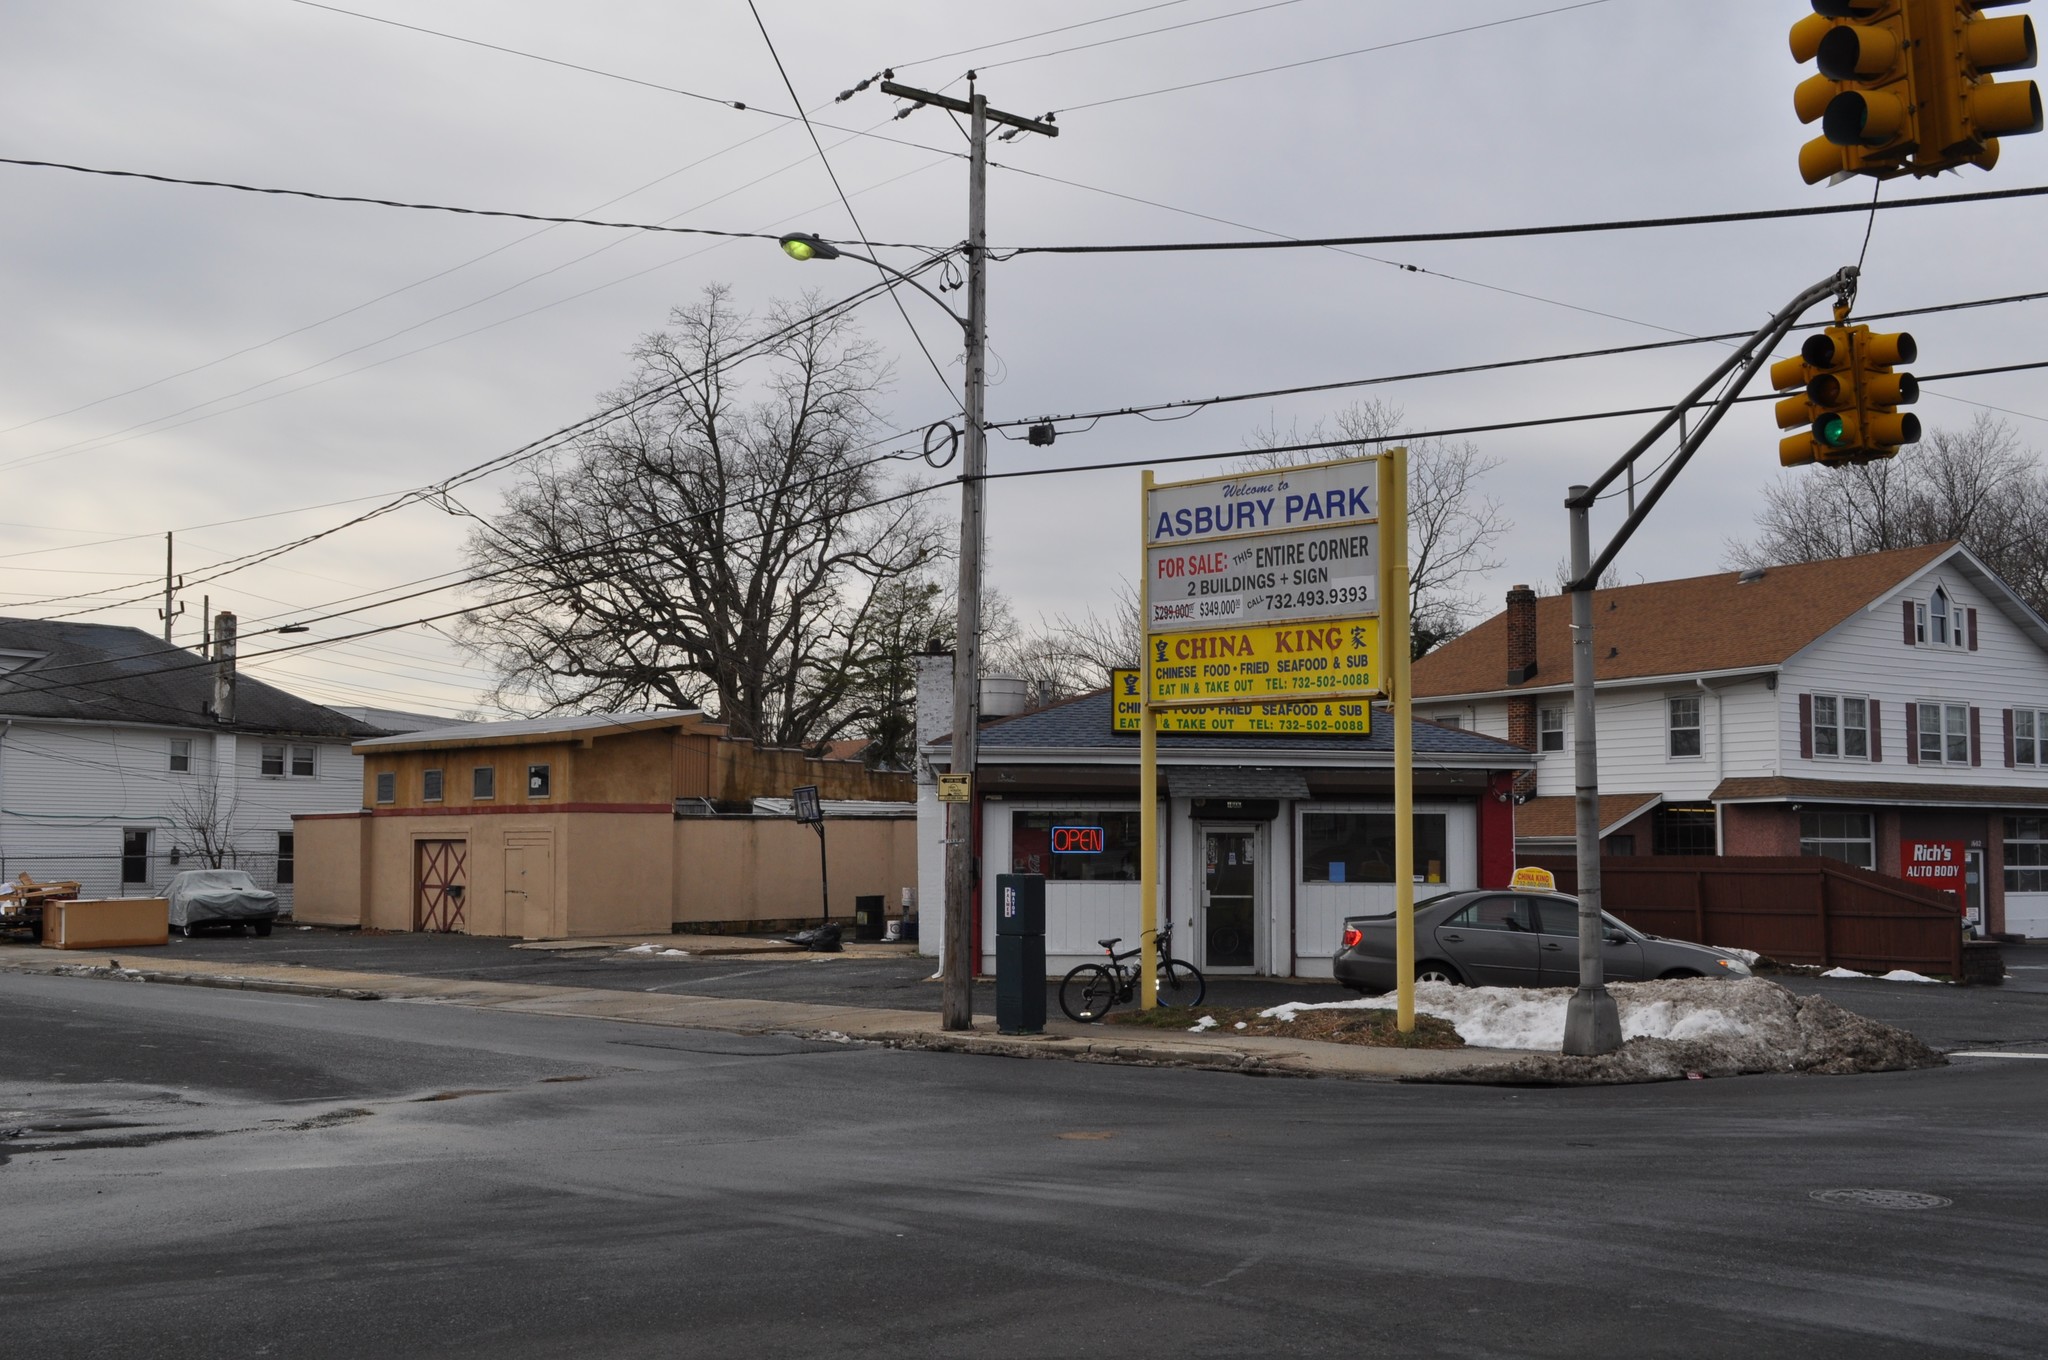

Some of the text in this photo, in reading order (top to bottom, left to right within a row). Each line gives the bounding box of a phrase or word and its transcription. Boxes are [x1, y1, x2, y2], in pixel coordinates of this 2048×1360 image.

[1222, 480, 1289, 499] Welcome to
[1155, 486, 1370, 539] ASBURY PARK
[1158, 535, 1369, 579] FOR SALE: THIS ENTIRE CORNER
[1187, 581, 1196, 597] 2
[1200, 572, 1276, 595] BUILDINGS
[1293, 567, 1328, 586] SIGN
[1247, 586, 1368, 610] CALL 732.493.9393
[1175, 627, 1343, 660] CHINA KING
[1350, 625, 1367, 650] 家
[1155, 639, 1169, 663] 皇
[1155, 654, 1369, 680] CHINESE FOOD FRIED SEAFOOD & SUB
[1159, 673, 1370, 696] EAT IN & TAKE OUT TEL: 732-502-0088
[1218, 704, 1252, 716] FRIED
[1262, 703, 1319, 716] SEAFOOD
[1324, 704, 1332, 716] &
[1339, 704, 1363, 717] SUB
[1119, 718, 1364, 731] EAT & TAKE OUT TEL: 732-502-0088
[1054, 829, 1102, 851] OPEN
[1913, 844, 1952, 861] Rich's
[1517, 873, 1550, 882] CHINA KING
[1906, 865, 1960, 877] AUTO BODY
